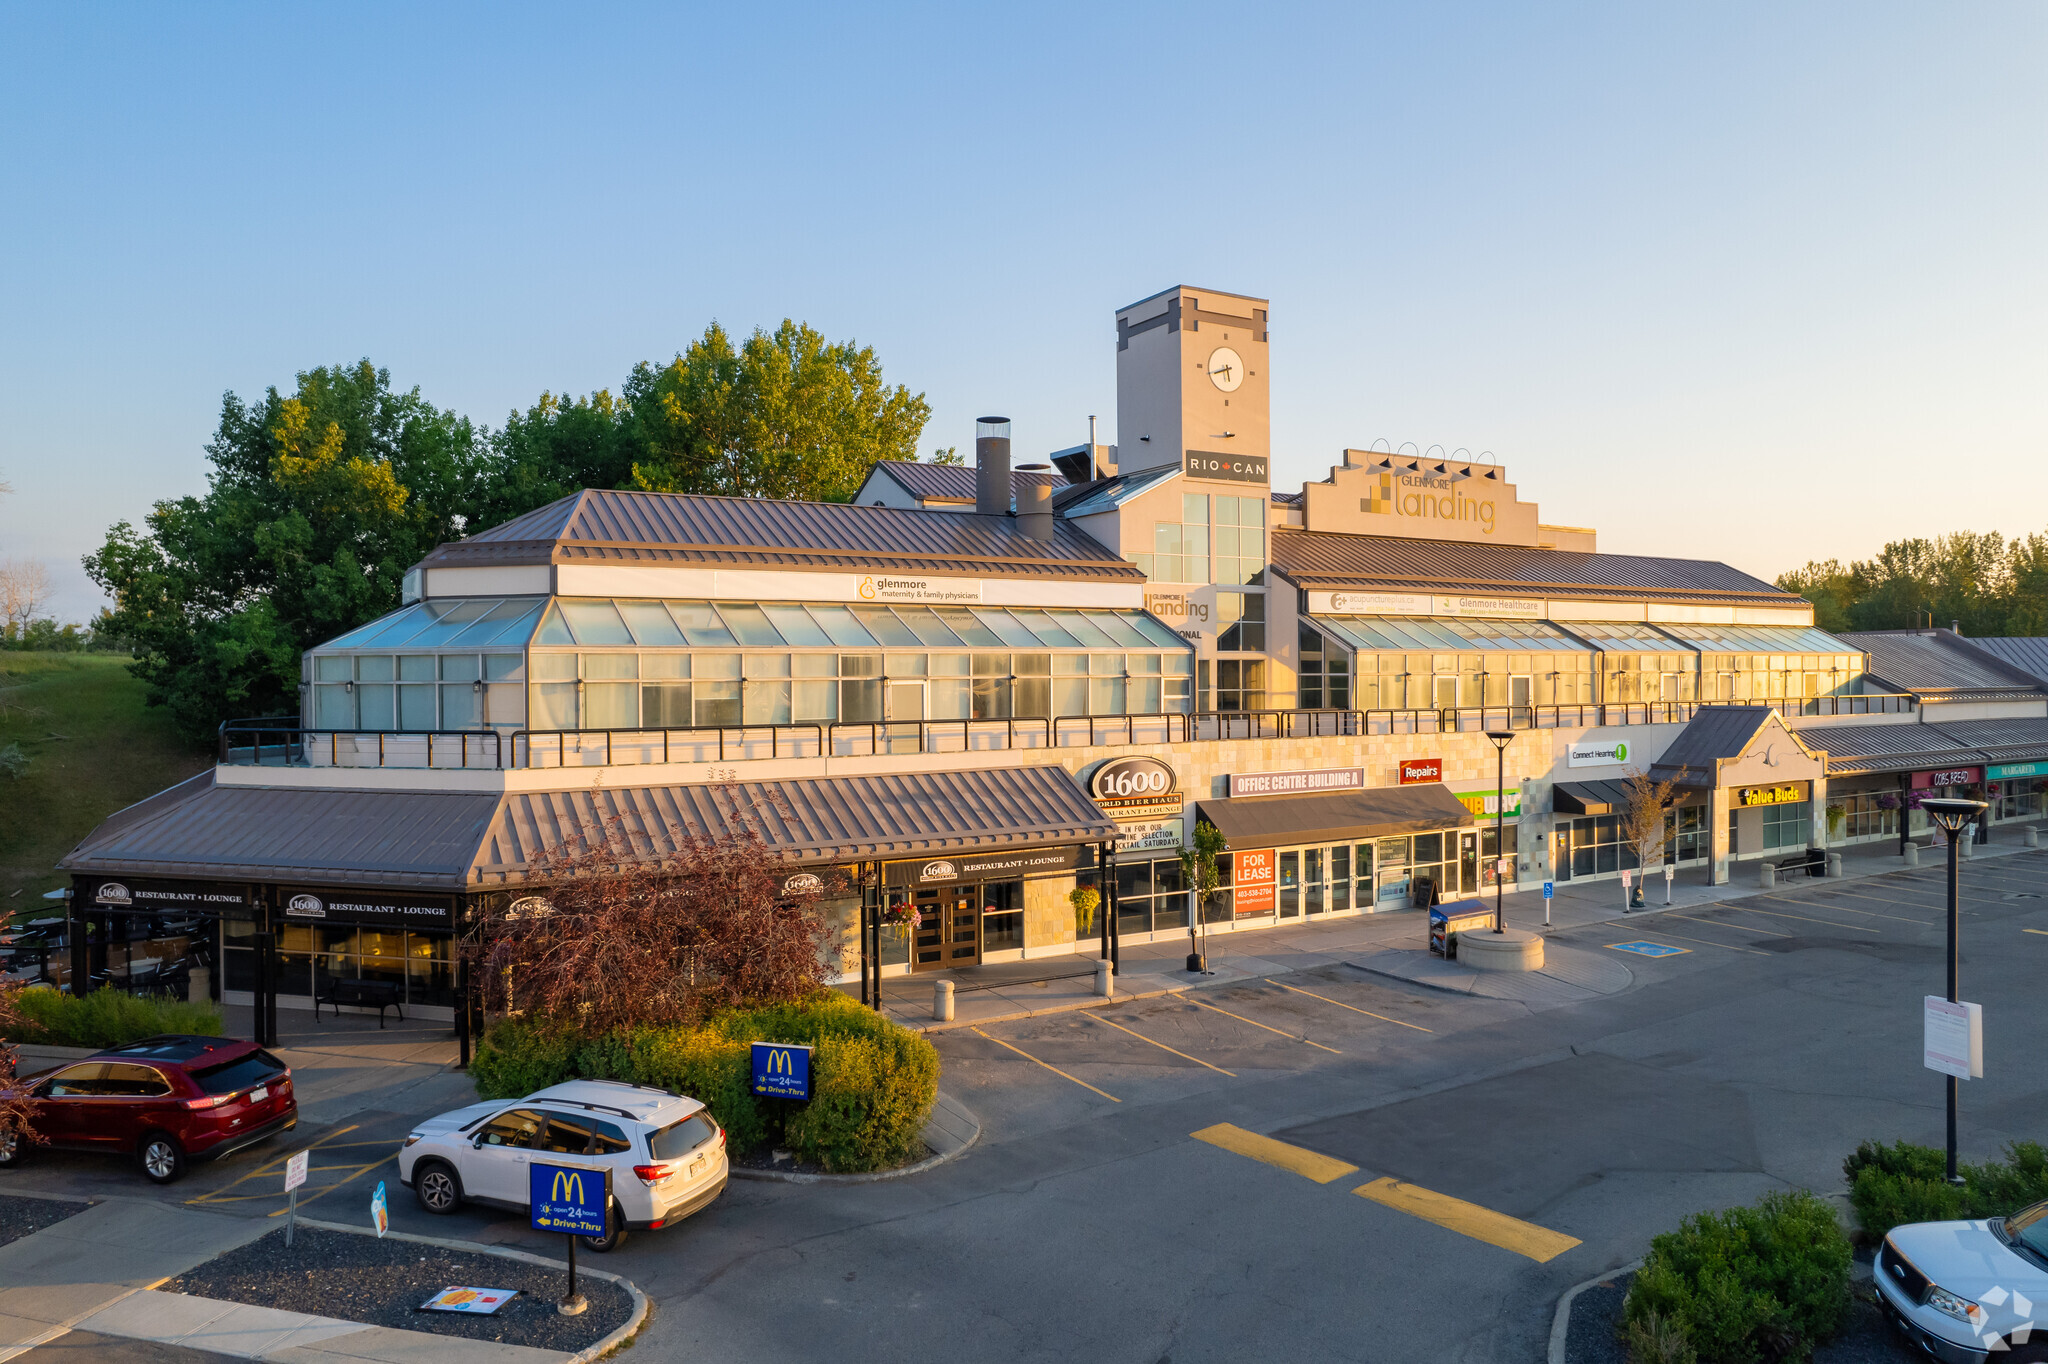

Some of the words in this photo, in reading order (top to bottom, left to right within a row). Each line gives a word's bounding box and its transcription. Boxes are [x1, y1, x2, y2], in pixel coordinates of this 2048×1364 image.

[1190, 458, 1219, 471] RIO
[1233, 462, 1265, 475] CAN
[1401, 475, 1450, 490] GLENMORE
[1395, 474, 1496, 534] landing
[877, 578, 927, 590] glenmore
[945, 592, 979, 600] physicians
[1149, 593, 1209, 622] landing
[1459, 597, 1497, 609] Glenmore
[1498, 599, 1538, 610] Healthcare
[1572, 750, 1594, 760] Connect
[1595, 749, 1616, 758] Hearing
[1405, 765, 1438, 780] Repairs
[2001, 764, 2036, 776] MARGARETA
[1104, 770, 1166, 797] 1600
[1238, 778, 1270, 792] OFFICE
[1271, 775, 1307, 789] CENTRE
[1308, 772, 1351, 788] BUILDING
[1352, 772, 1358, 785] A
[1934, 772, 1949, 786] COBS
[1124, 798, 1149, 806] BIER
[1152, 796, 1179, 804] HAUS
[1746, 789, 1774, 806] Value
[1775, 785, 1799, 802] Buds
[1148, 805, 1181, 814] LOUNGE
[1457, 792, 1521, 815] UBWAY
[1150, 823, 1162, 831] OUR
[1141, 831, 1174, 840] SELECTION
[1144, 838, 1180, 847] SATURDAYS
[927, 865, 951, 875] 1600
[964, 860, 1023, 872] RESTAURANT
[1030, 856, 1065, 866] LOUNGE
[1243, 854, 1265, 867] FOR
[1238, 867, 1272, 881] LEASE
[103, 888, 126, 898] 1600
[135, 891, 196, 901] RESTAURANT
[203, 894, 242, 903] LOUNGE
[294, 900, 318, 910] 1600
[329, 903, 396, 913] RESTAURANT
[403, 906, 446, 916] LOUNGE
[779, 1076, 791, 1086] 24
[768, 1086, 805, 1096] Drive-Thru
[568, 1207, 583, 1218] 24
[553, 1218, 602, 1231] Drive-Thru
